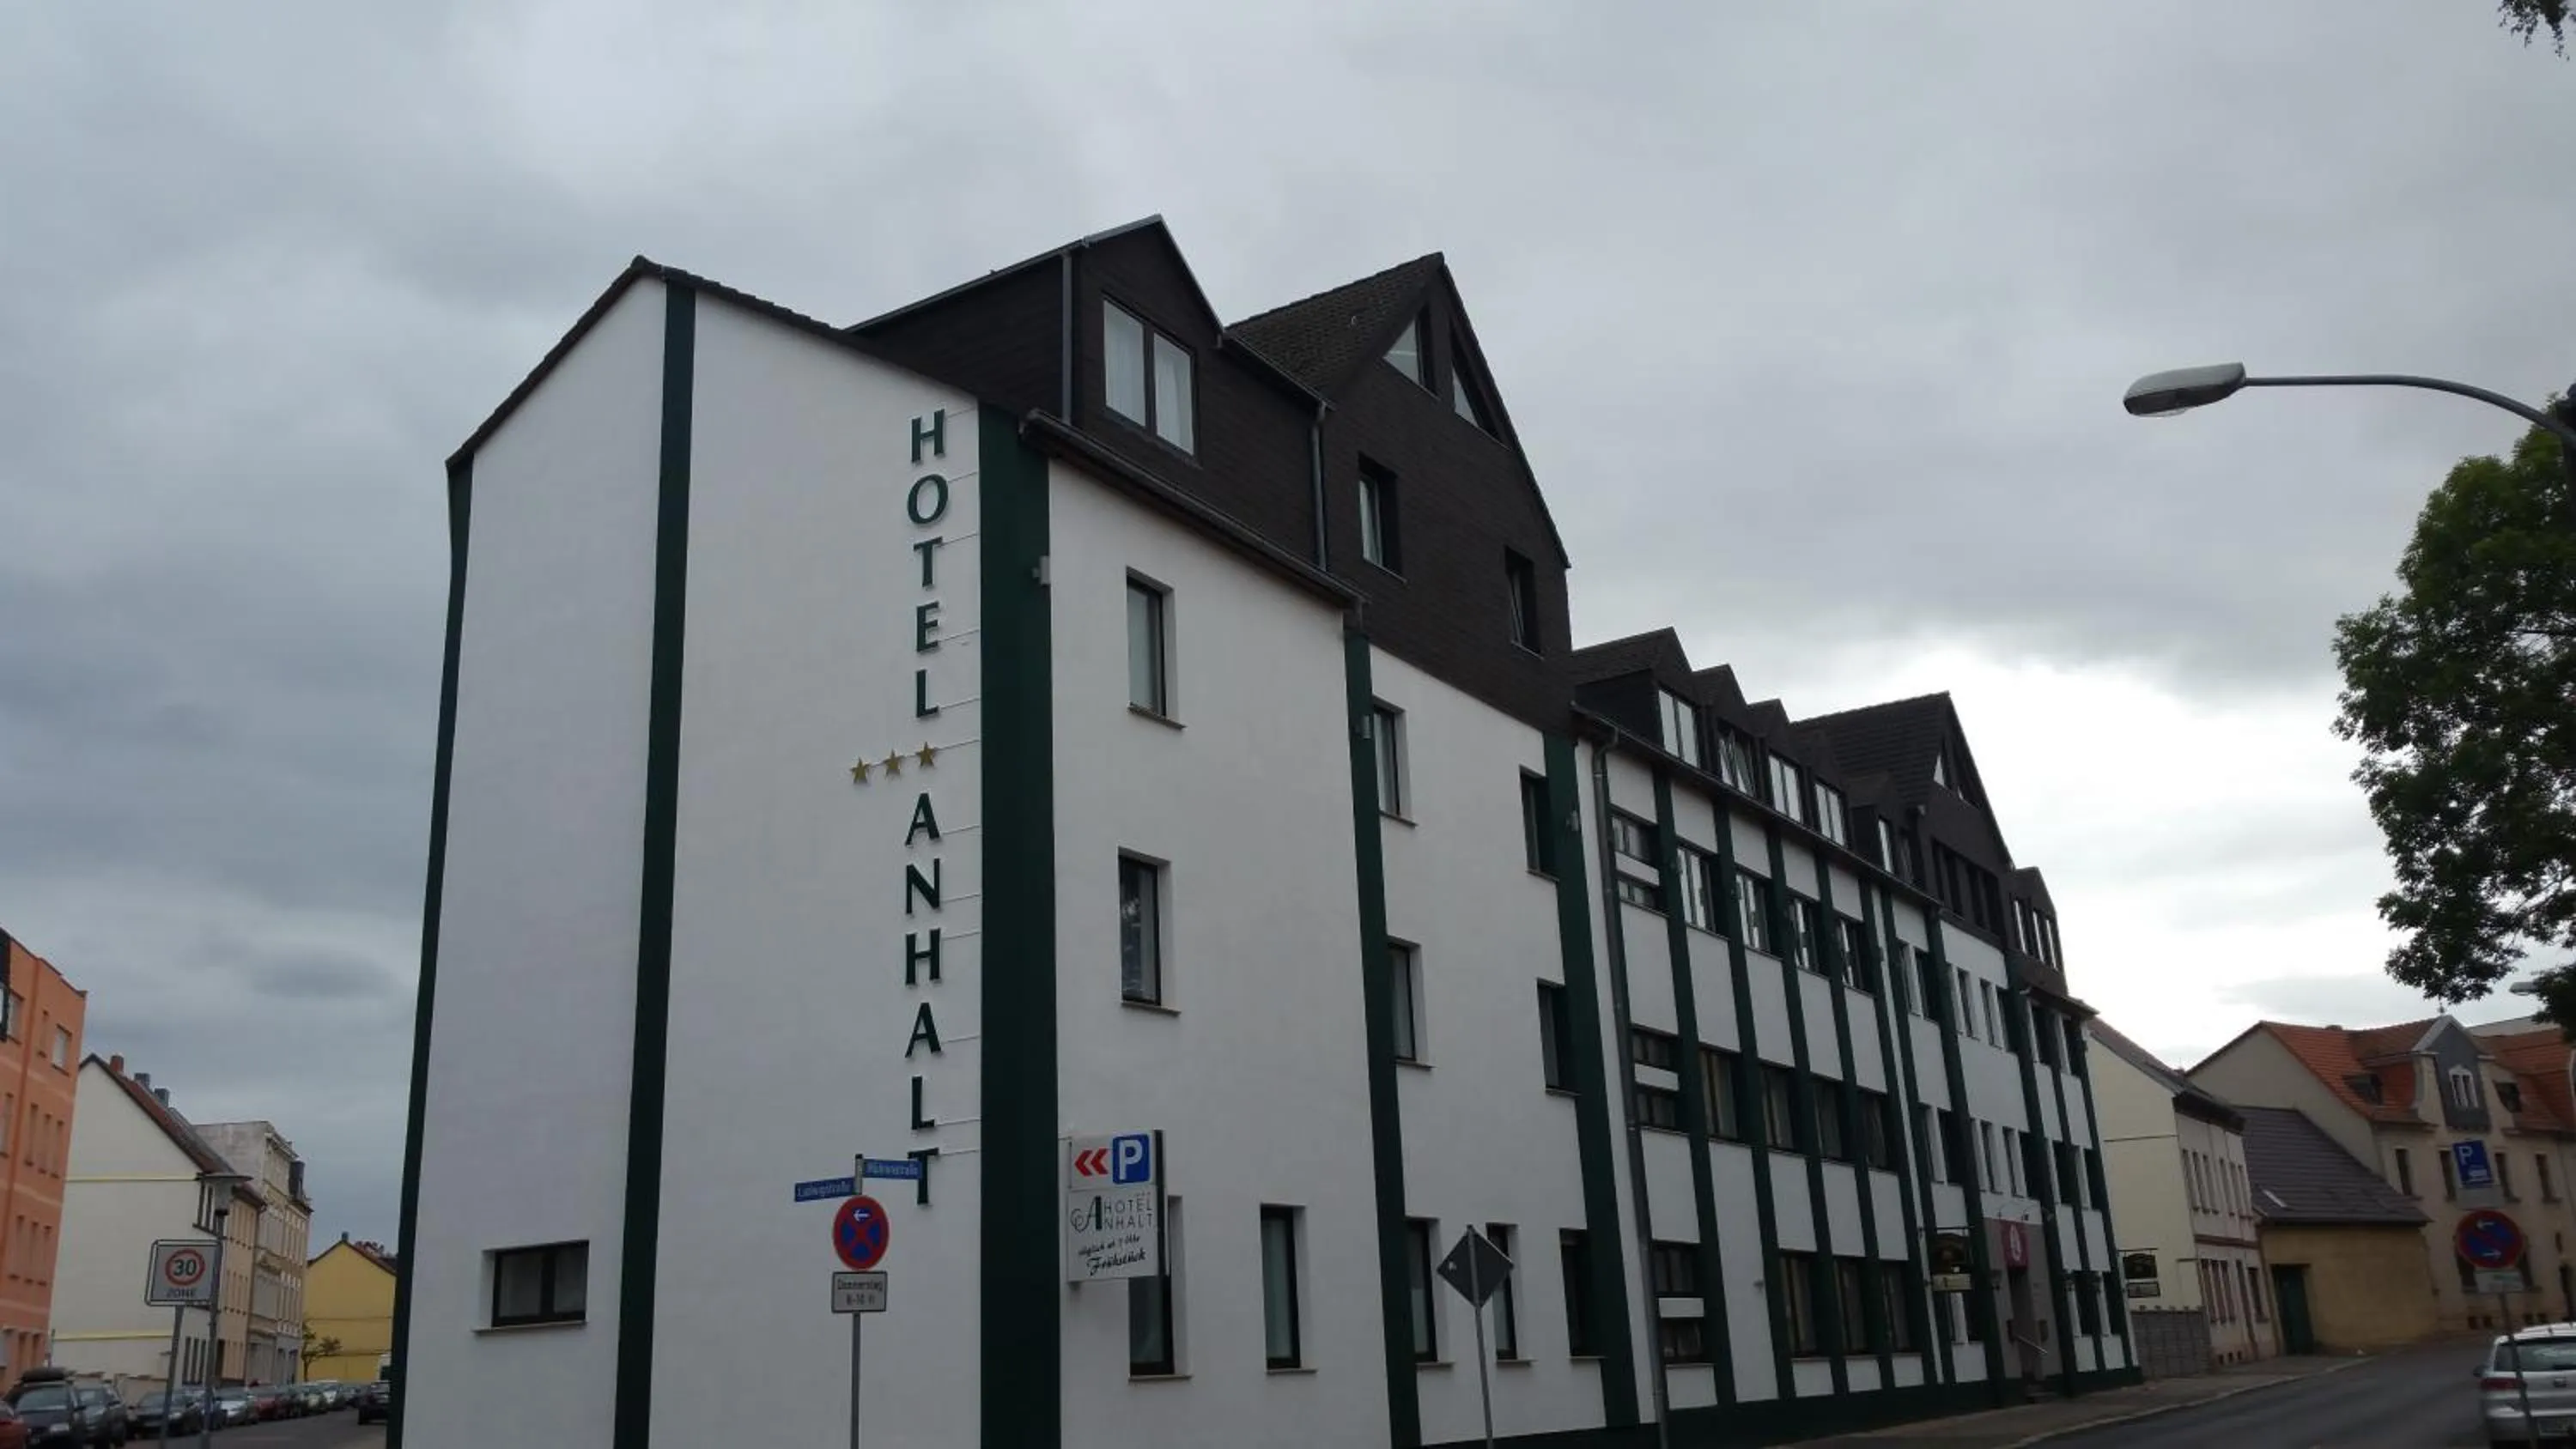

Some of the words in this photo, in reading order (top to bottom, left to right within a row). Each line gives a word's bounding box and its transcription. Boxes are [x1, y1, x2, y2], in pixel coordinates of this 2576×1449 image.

[907, 409, 949, 718] HOTEL
[905, 792, 943, 1205] ANHALT
[1119, 1139, 1143, 1180] P
[1103, 1197, 1153, 1214] HOTEL
[173, 1258, 197, 1276] 30
[166, 1288, 196, 1299] ZONE
